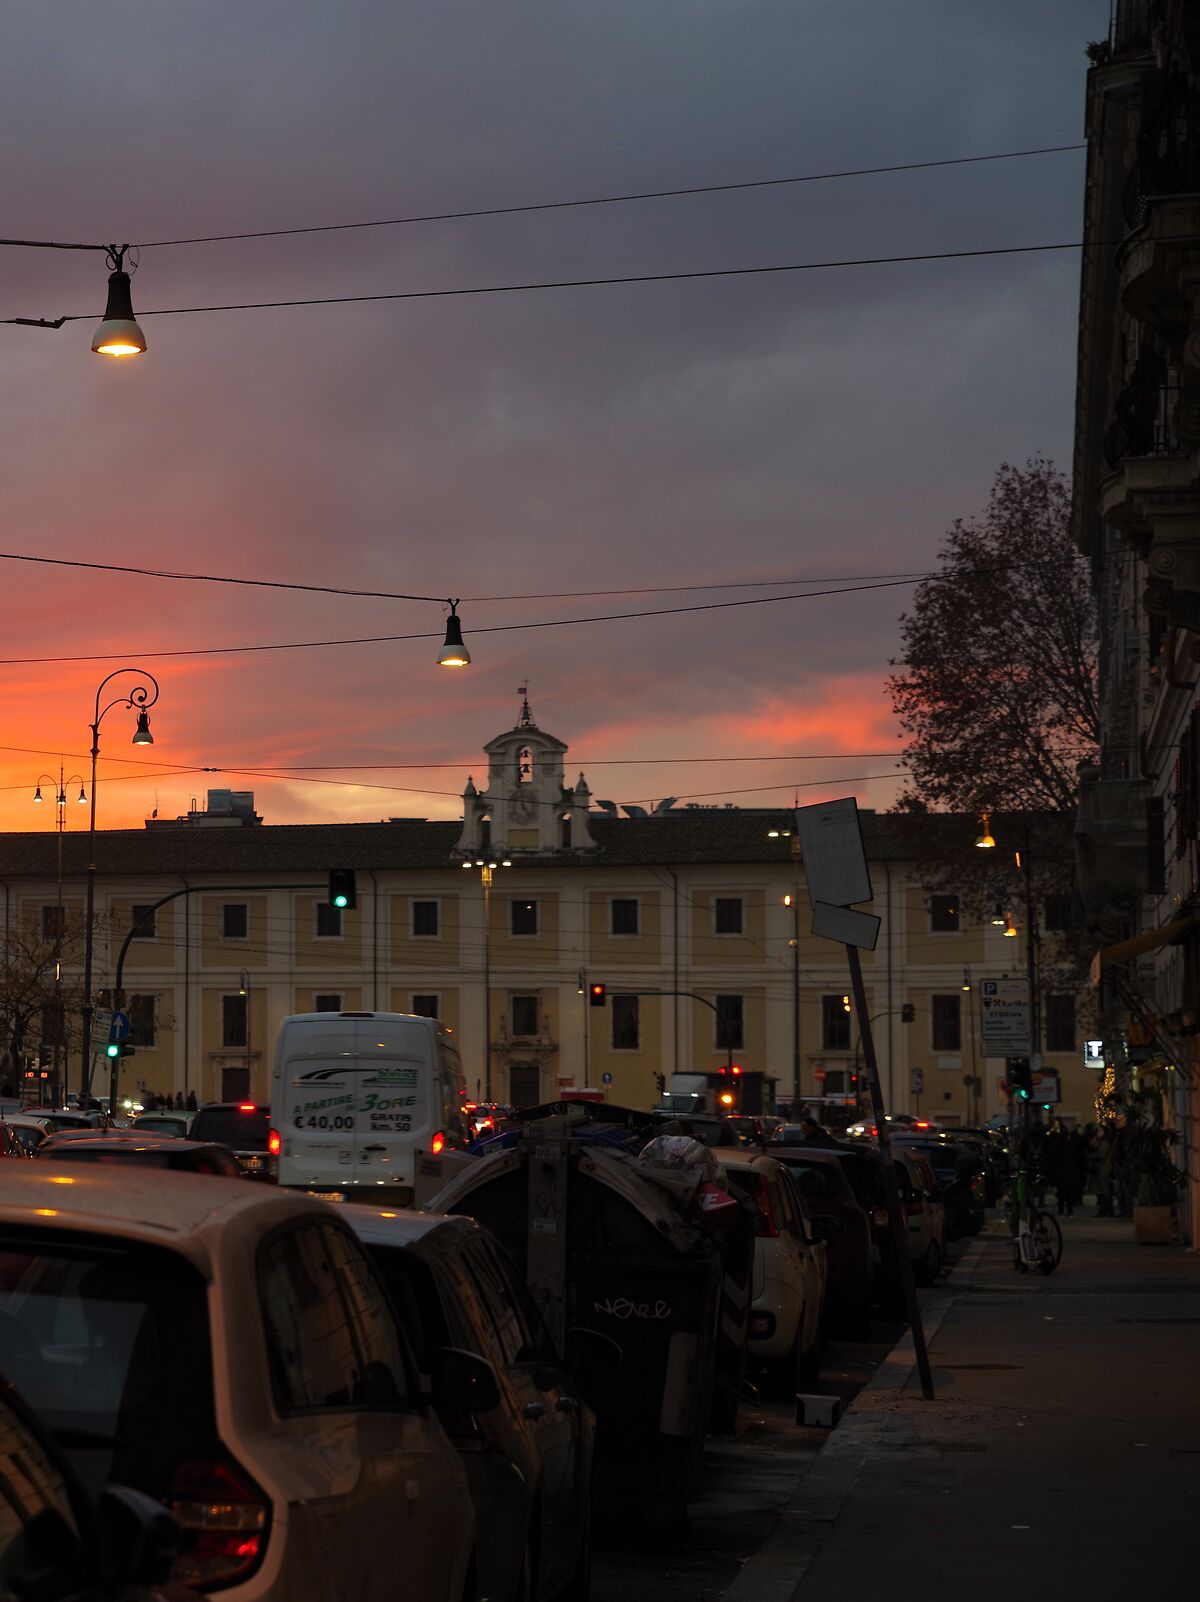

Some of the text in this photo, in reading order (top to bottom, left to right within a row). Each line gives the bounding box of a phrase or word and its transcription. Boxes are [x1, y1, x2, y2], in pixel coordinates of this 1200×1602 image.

[293, 1104, 302, 1114] A
[303, 1094, 353, 1112] PARTIRE
[294, 1115, 354, 1132] € 40,00
[370, 1113, 413, 1122] GRATIS
[395, 1122, 411, 1132] 50
